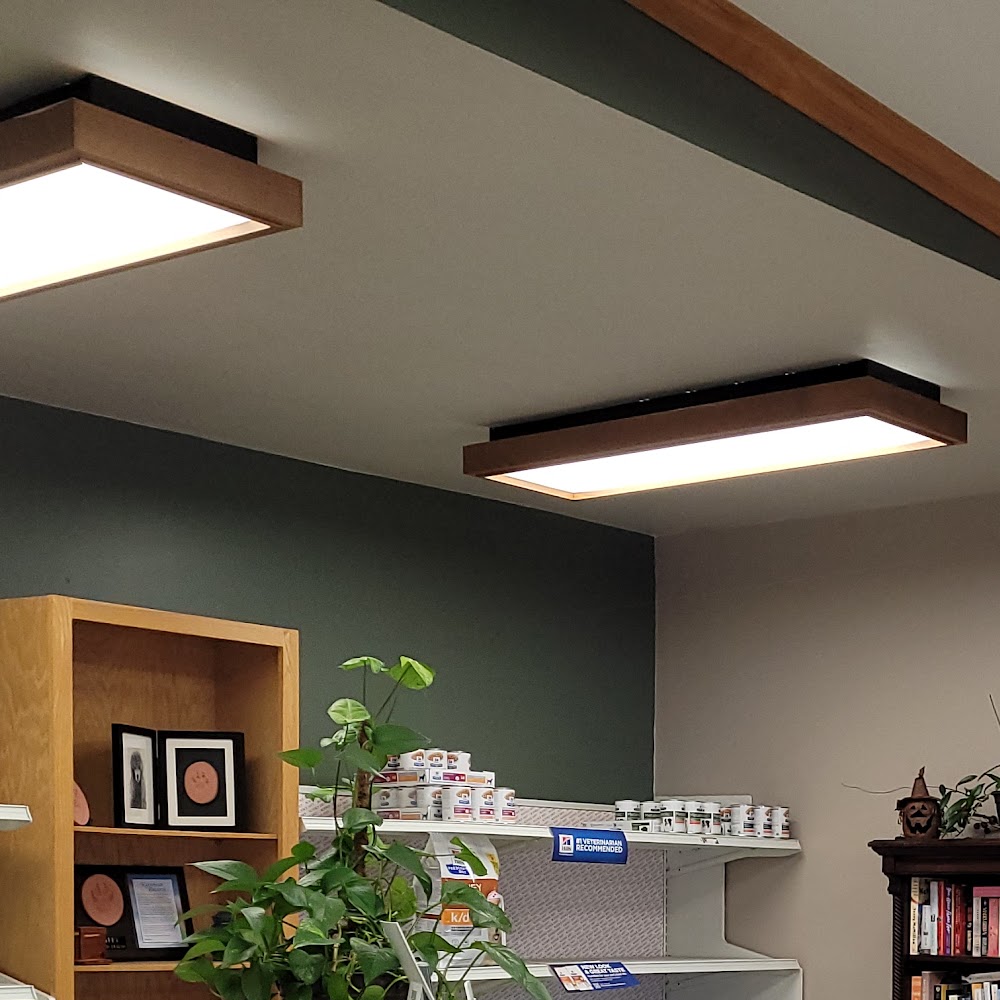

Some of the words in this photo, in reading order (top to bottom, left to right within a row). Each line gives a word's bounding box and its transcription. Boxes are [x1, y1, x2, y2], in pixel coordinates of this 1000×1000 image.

[583, 838, 622, 846] VETERINARIAN
[576, 845, 623, 853] RECOMMENDED
[451, 912, 469, 923] k/d
